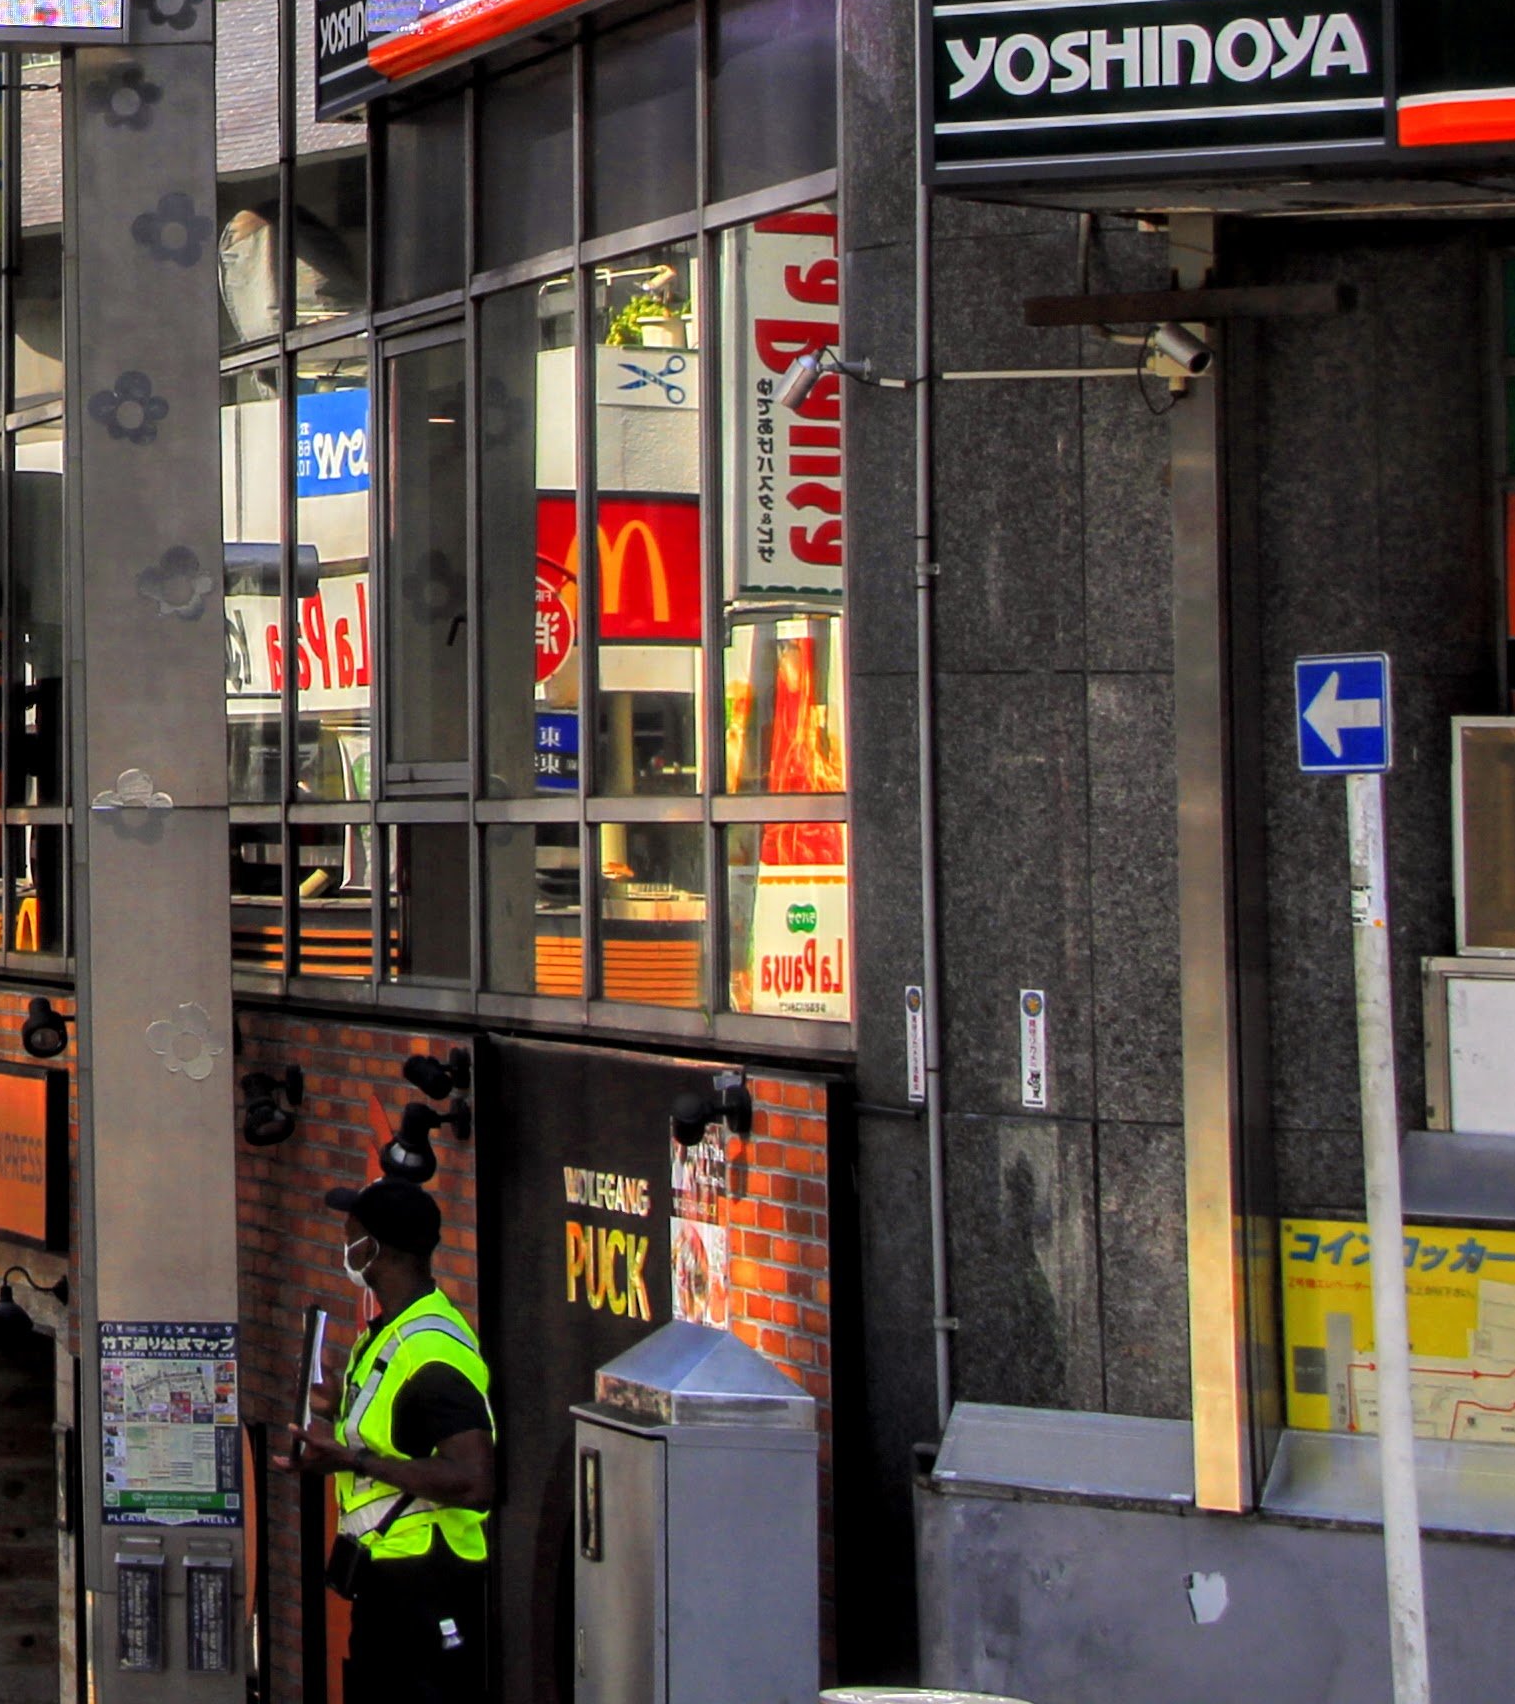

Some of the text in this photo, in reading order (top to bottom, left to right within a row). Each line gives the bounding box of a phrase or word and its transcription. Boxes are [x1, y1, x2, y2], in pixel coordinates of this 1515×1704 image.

[945, 12, 1368, 100] YOSHINOYA
[562, 1165, 649, 1216] WOLFGANG
[564, 1220, 651, 1322] PUCK
[101, 1336, 236, 1352] 竹下通り公式マップ
